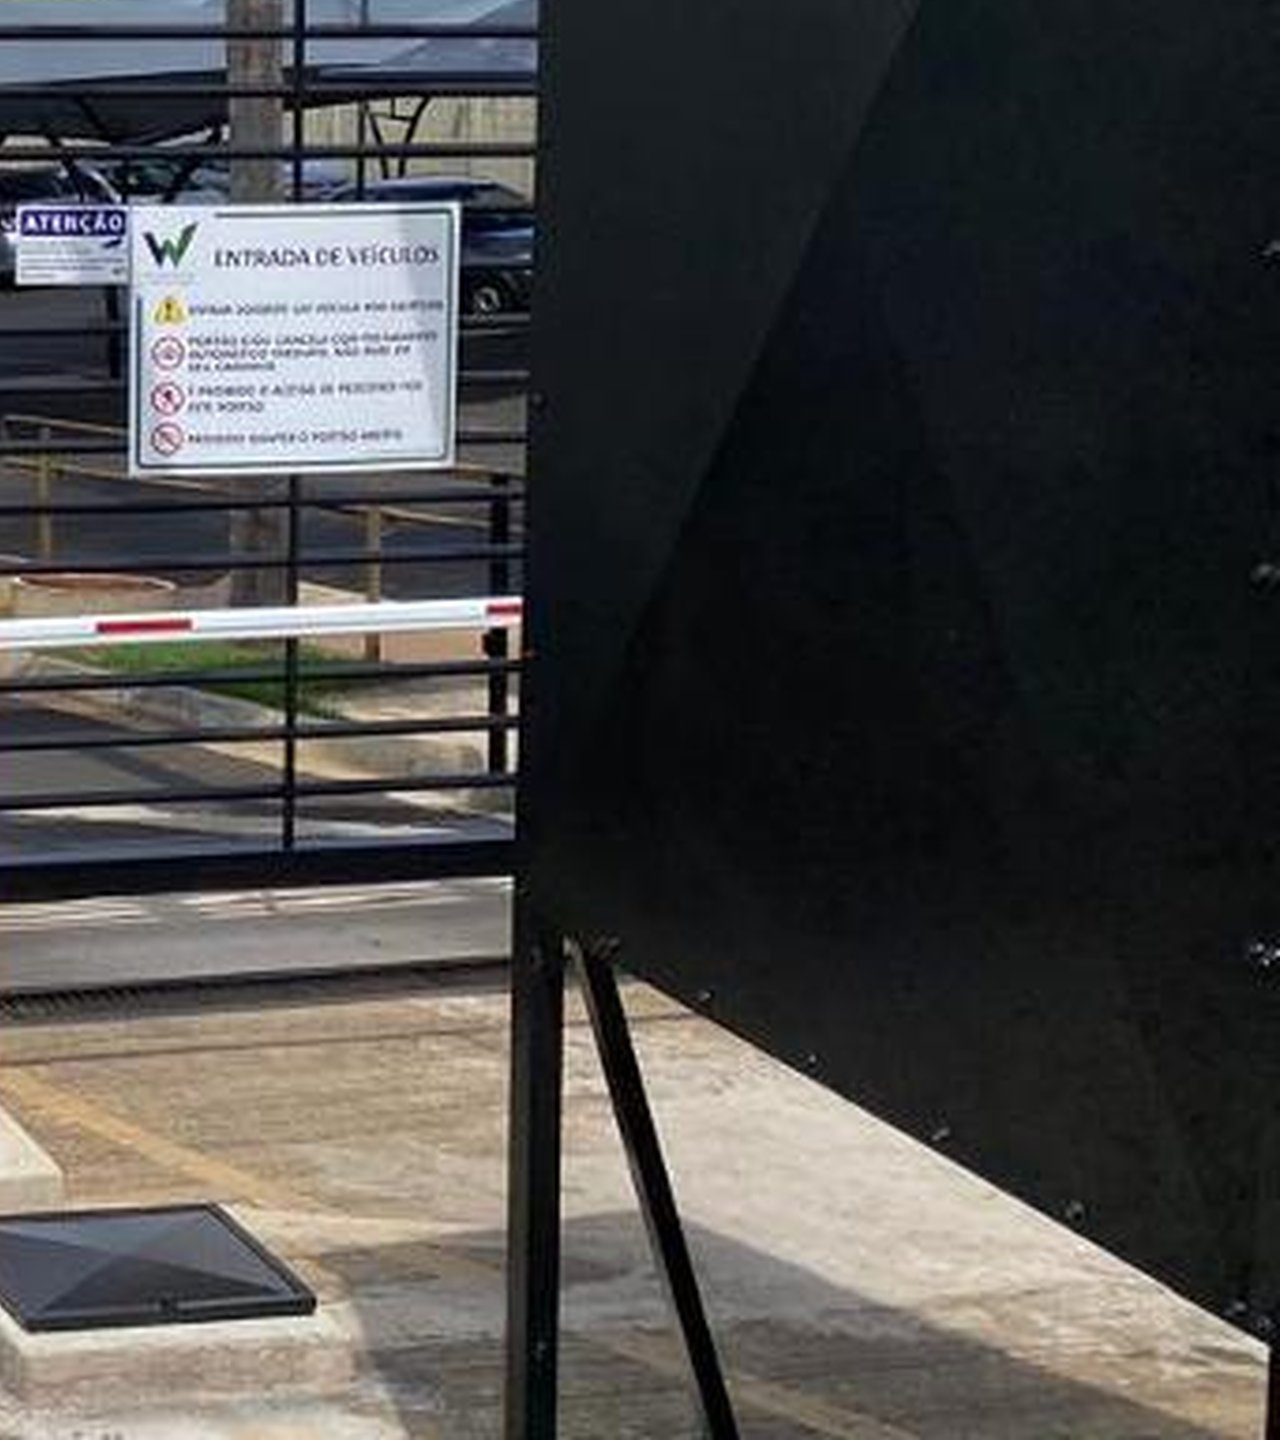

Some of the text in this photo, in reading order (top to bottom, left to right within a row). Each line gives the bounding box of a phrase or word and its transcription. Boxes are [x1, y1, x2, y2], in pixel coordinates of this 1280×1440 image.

[23, 212, 122, 234] ATENÇÃO
[214, 241, 440, 268] ENTRADA DE VEÍCULOS
